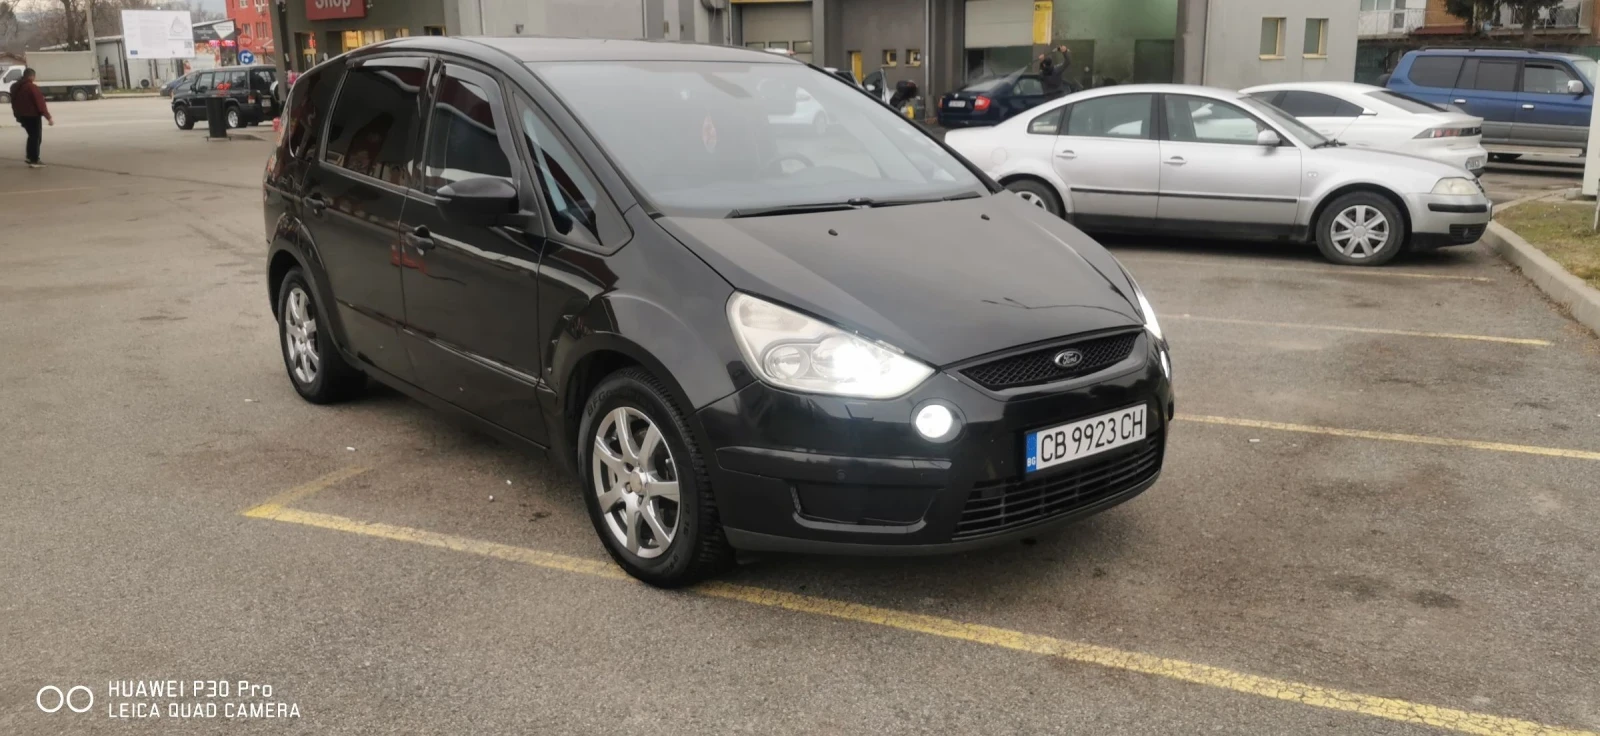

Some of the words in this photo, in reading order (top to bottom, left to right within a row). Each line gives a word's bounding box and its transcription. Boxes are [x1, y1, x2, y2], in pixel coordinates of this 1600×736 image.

[1041, 431, 1067, 463] CB
[1072, 418, 1117, 455] 9923
[1121, 409, 1143, 440] CH
[1027, 457, 1036, 467] BG
